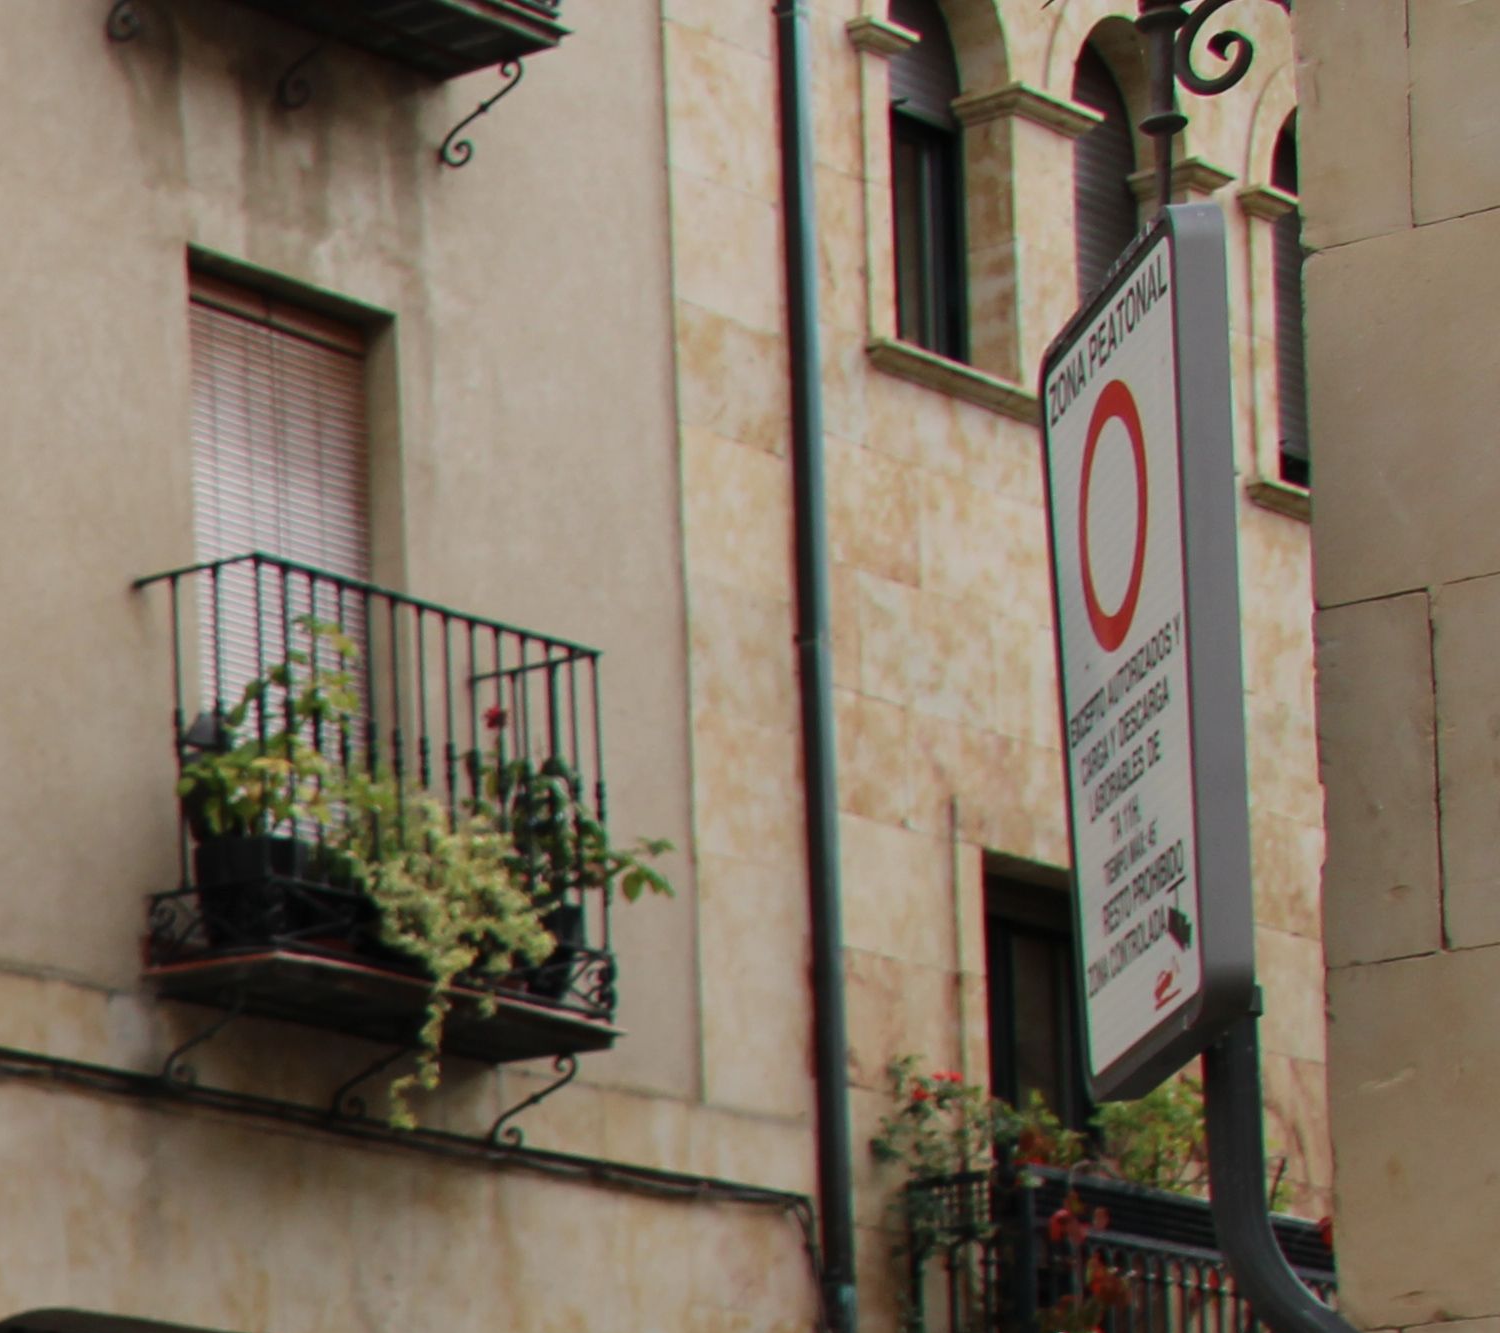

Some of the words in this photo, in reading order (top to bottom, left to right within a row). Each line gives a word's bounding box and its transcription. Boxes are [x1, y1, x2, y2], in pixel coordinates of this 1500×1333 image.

[1049, 351, 1086, 427] ZONA
[1088, 255, 1167, 379] PEATONAL
[1108, 622, 1172, 704] AUTORIZADOS
[1173, 612, 1181, 645] Y
[1119, 675, 1170, 748] DESCARGA
[1147, 729, 1161, 768] DE
[1102, 884, 1132, 936] RESTO
[1132, 838, 1184, 908] PROHIBIDO
[1109, 904, 1167, 979] CONTROLADA
